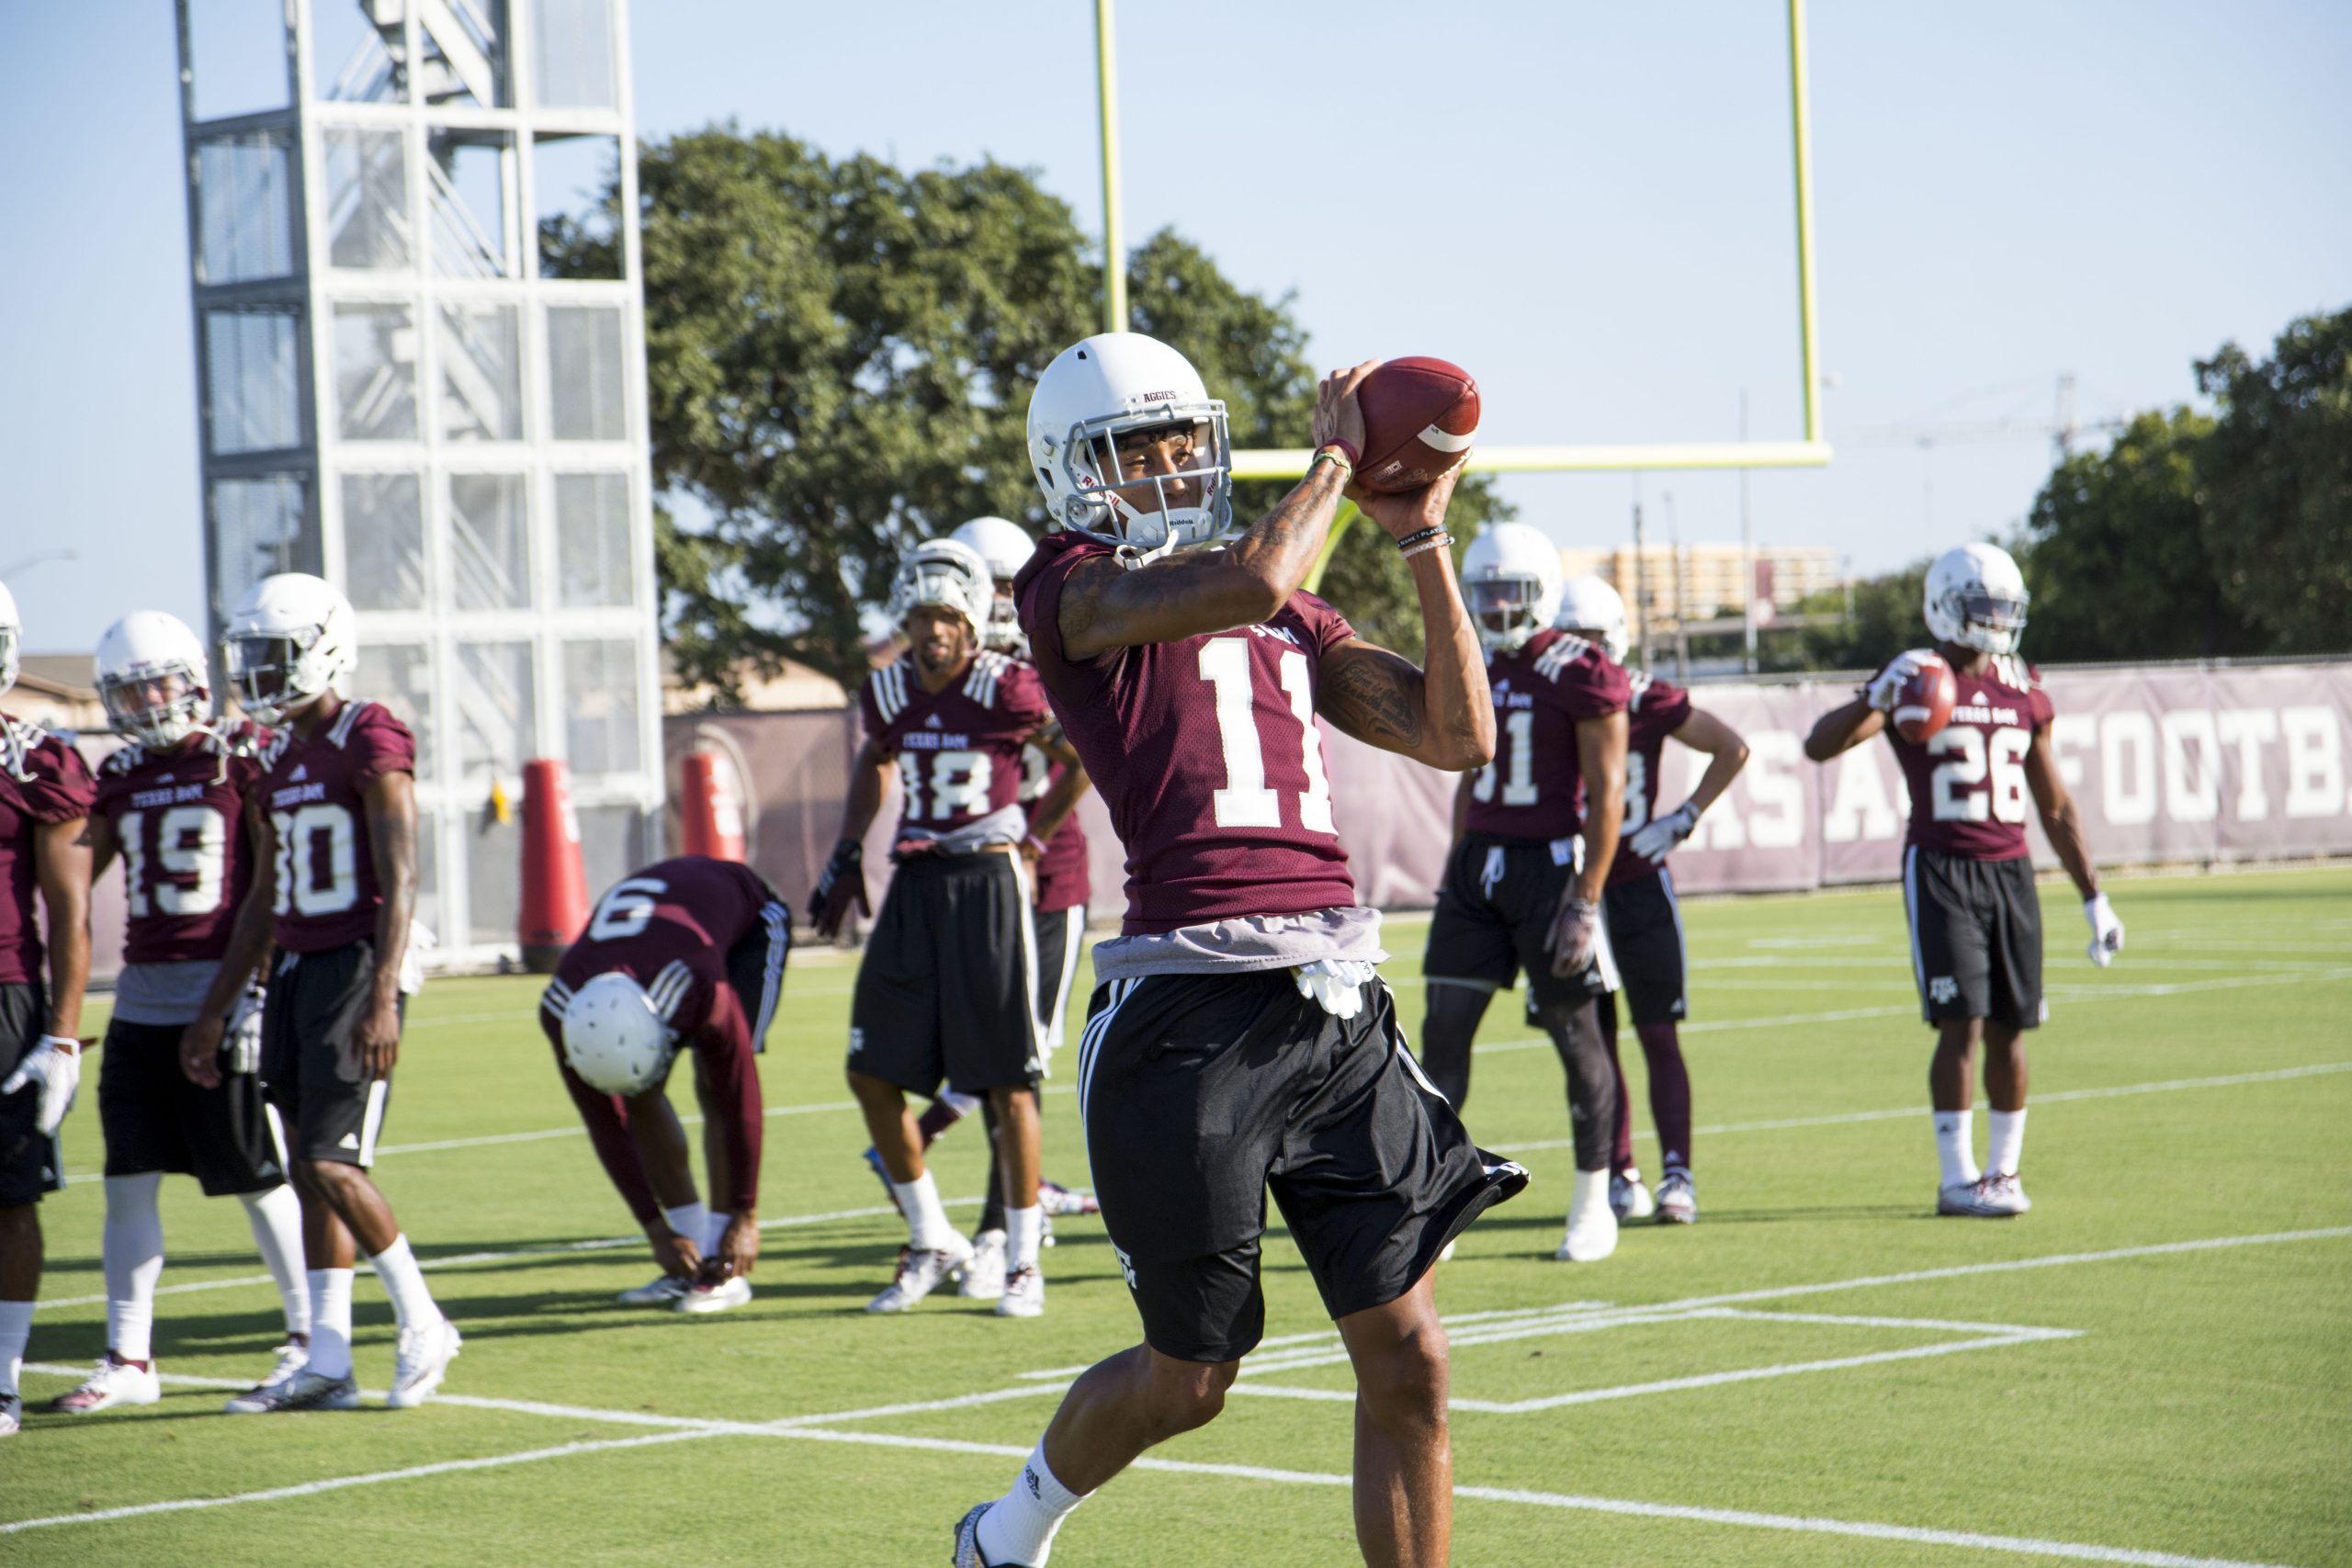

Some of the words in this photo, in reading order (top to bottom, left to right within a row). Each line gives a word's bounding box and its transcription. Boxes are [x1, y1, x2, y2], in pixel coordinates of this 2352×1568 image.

[1144, 390, 1176, 402] AGGIES
[1198, 637, 1339, 836] 11
[1928, 726, 2032, 823] 26
[2050, 705, 2352, 825] FOOTB
[119, 807, 226, 918] 19
